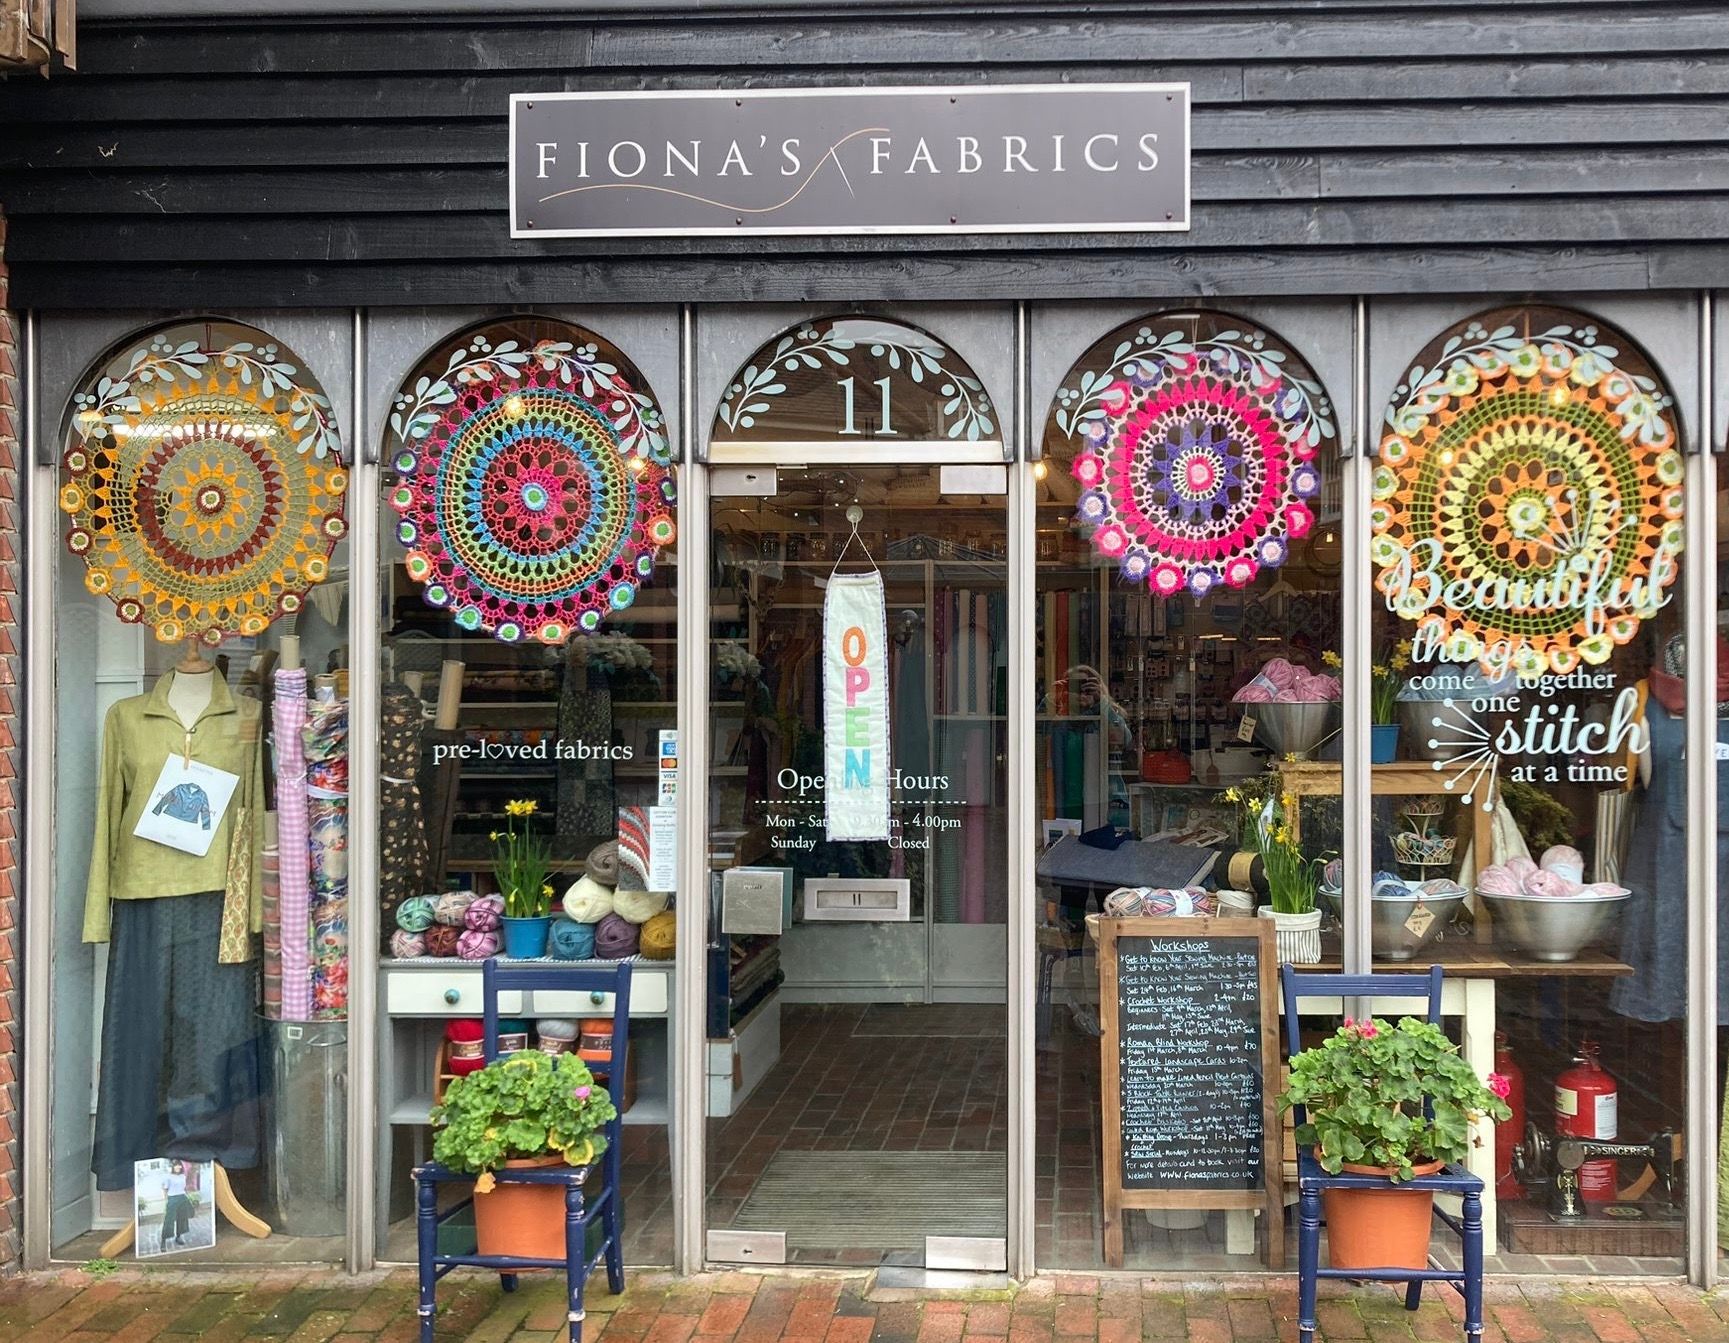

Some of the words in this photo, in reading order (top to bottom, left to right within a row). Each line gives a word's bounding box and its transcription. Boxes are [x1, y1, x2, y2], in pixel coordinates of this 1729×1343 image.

[535, 135, 802, 178] FIONA'S
[870, 132, 1161, 174] FABRICS
[837, 376, 898, 435] 11
[1385, 538, 1673, 637] Beautiful
[1409, 675, 1475, 690] come
[1515, 666, 1617, 697] together
[842, 626, 870, 789] OPEN
[1472, 696, 1521, 713] one
[1495, 687, 1651, 755] stitch
[555, 739, 634, 760] fabrics
[1511, 764, 1537, 782] at
[1544, 765, 1560, 782] a
[1567, 759, 1629, 782] time
[766, 814, 796, 828] Mon
[912, 812, 962, 832] 4.00pm
[771, 835, 817, 852] Sunday
[888, 835, 930, 849] Closed
[1150, 939, 1209, 954] Workshops
[1140, 955, 1148, 963] to
[1140, 976, 1148, 984] to
[1127, 996, 1154, 1006] Crochet
[1602, 1146, 1637, 1156] SINGER
[1125, 1160, 1137, 1169] For
